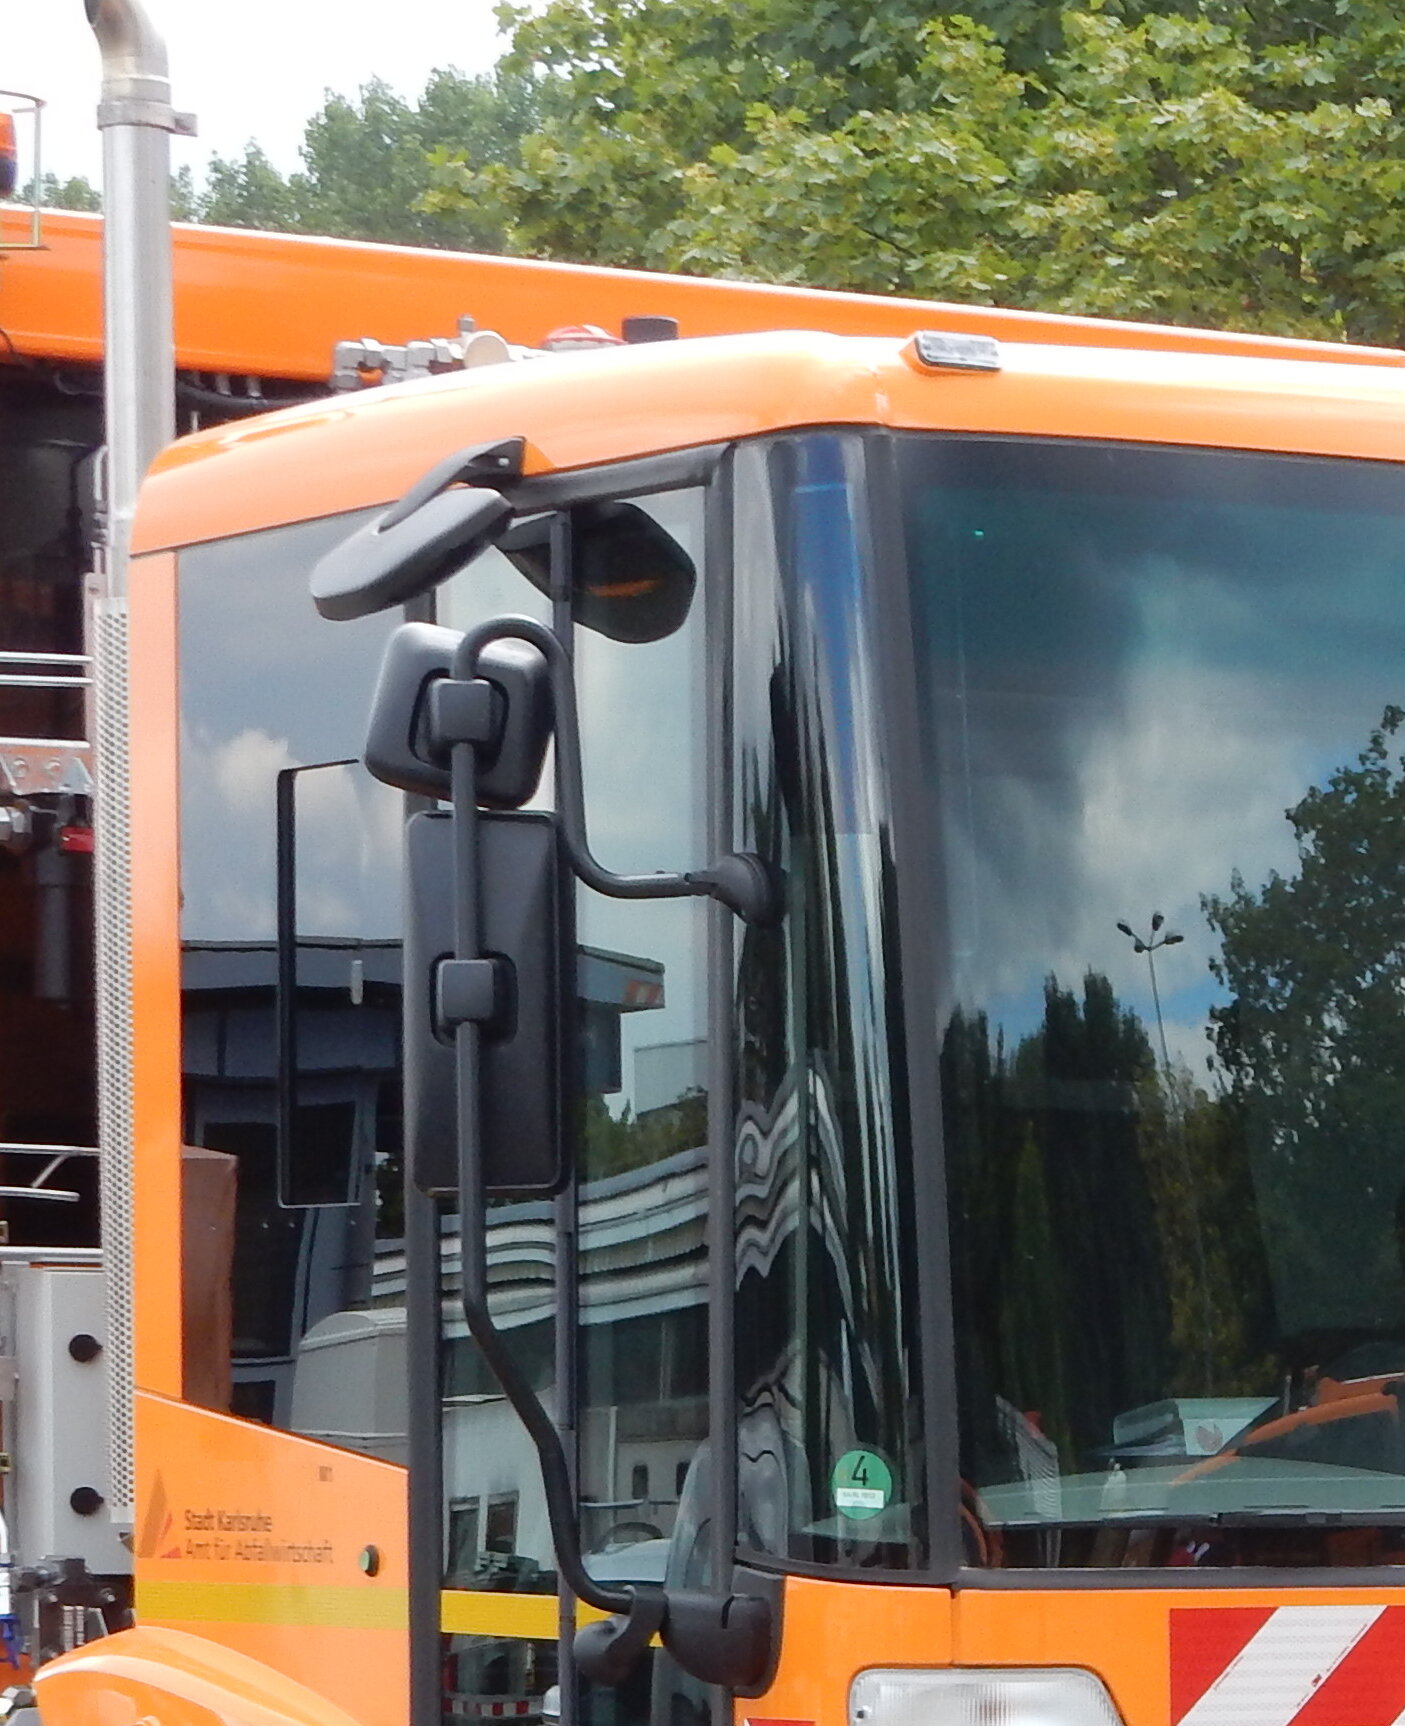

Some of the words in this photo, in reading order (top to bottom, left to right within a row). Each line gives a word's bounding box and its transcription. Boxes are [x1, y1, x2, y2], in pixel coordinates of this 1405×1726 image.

[851, 1455, 869, 1486] 4
[185, 1508, 214, 1531] Stadt
[218, 1509, 272, 1531] Karlsruhe
